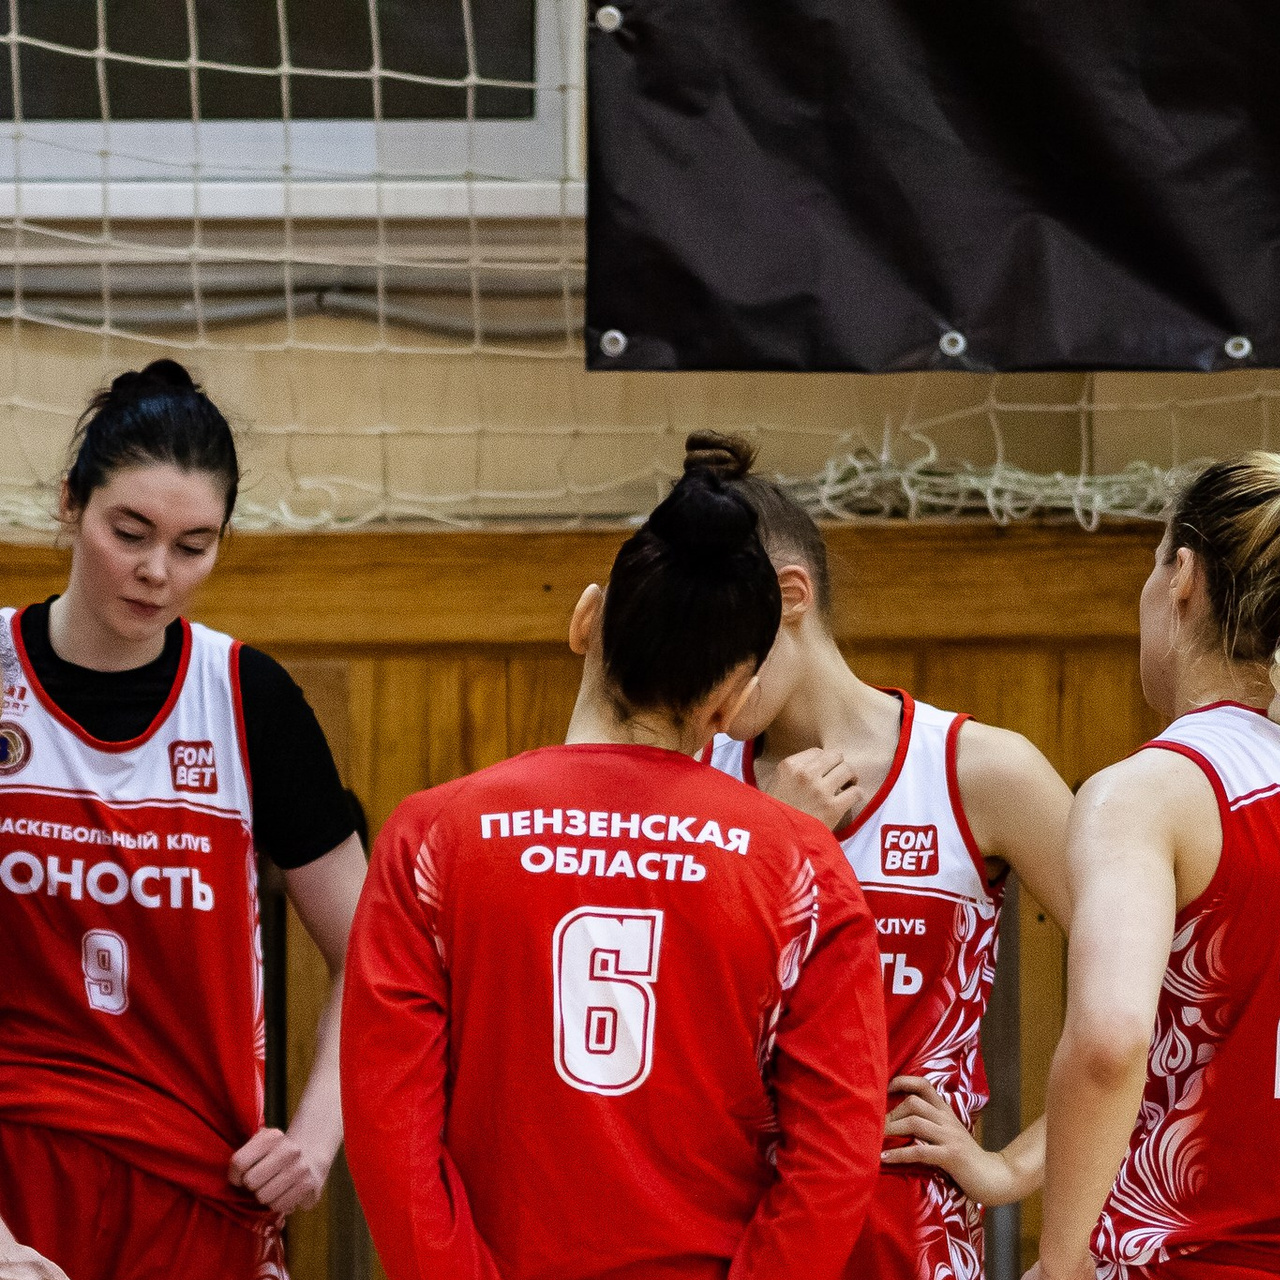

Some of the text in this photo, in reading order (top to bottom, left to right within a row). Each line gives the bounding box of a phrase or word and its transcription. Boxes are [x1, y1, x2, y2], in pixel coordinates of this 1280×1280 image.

[174, 746, 213, 766] FON
[176, 766, 215, 787] BET
[480, 808, 751, 855] ПЕНЗЕНСКАЯ
[885, 830, 933, 850] FON
[166, 833, 211, 853] КЛУБ
[520, 846, 707, 882] ОБЛАСТЬ
[885, 850, 934, 870] BET
[875, 918, 926, 935] КЛУБ
[81, 928, 129, 1015] 9
[552, 905, 664, 1096] 6
